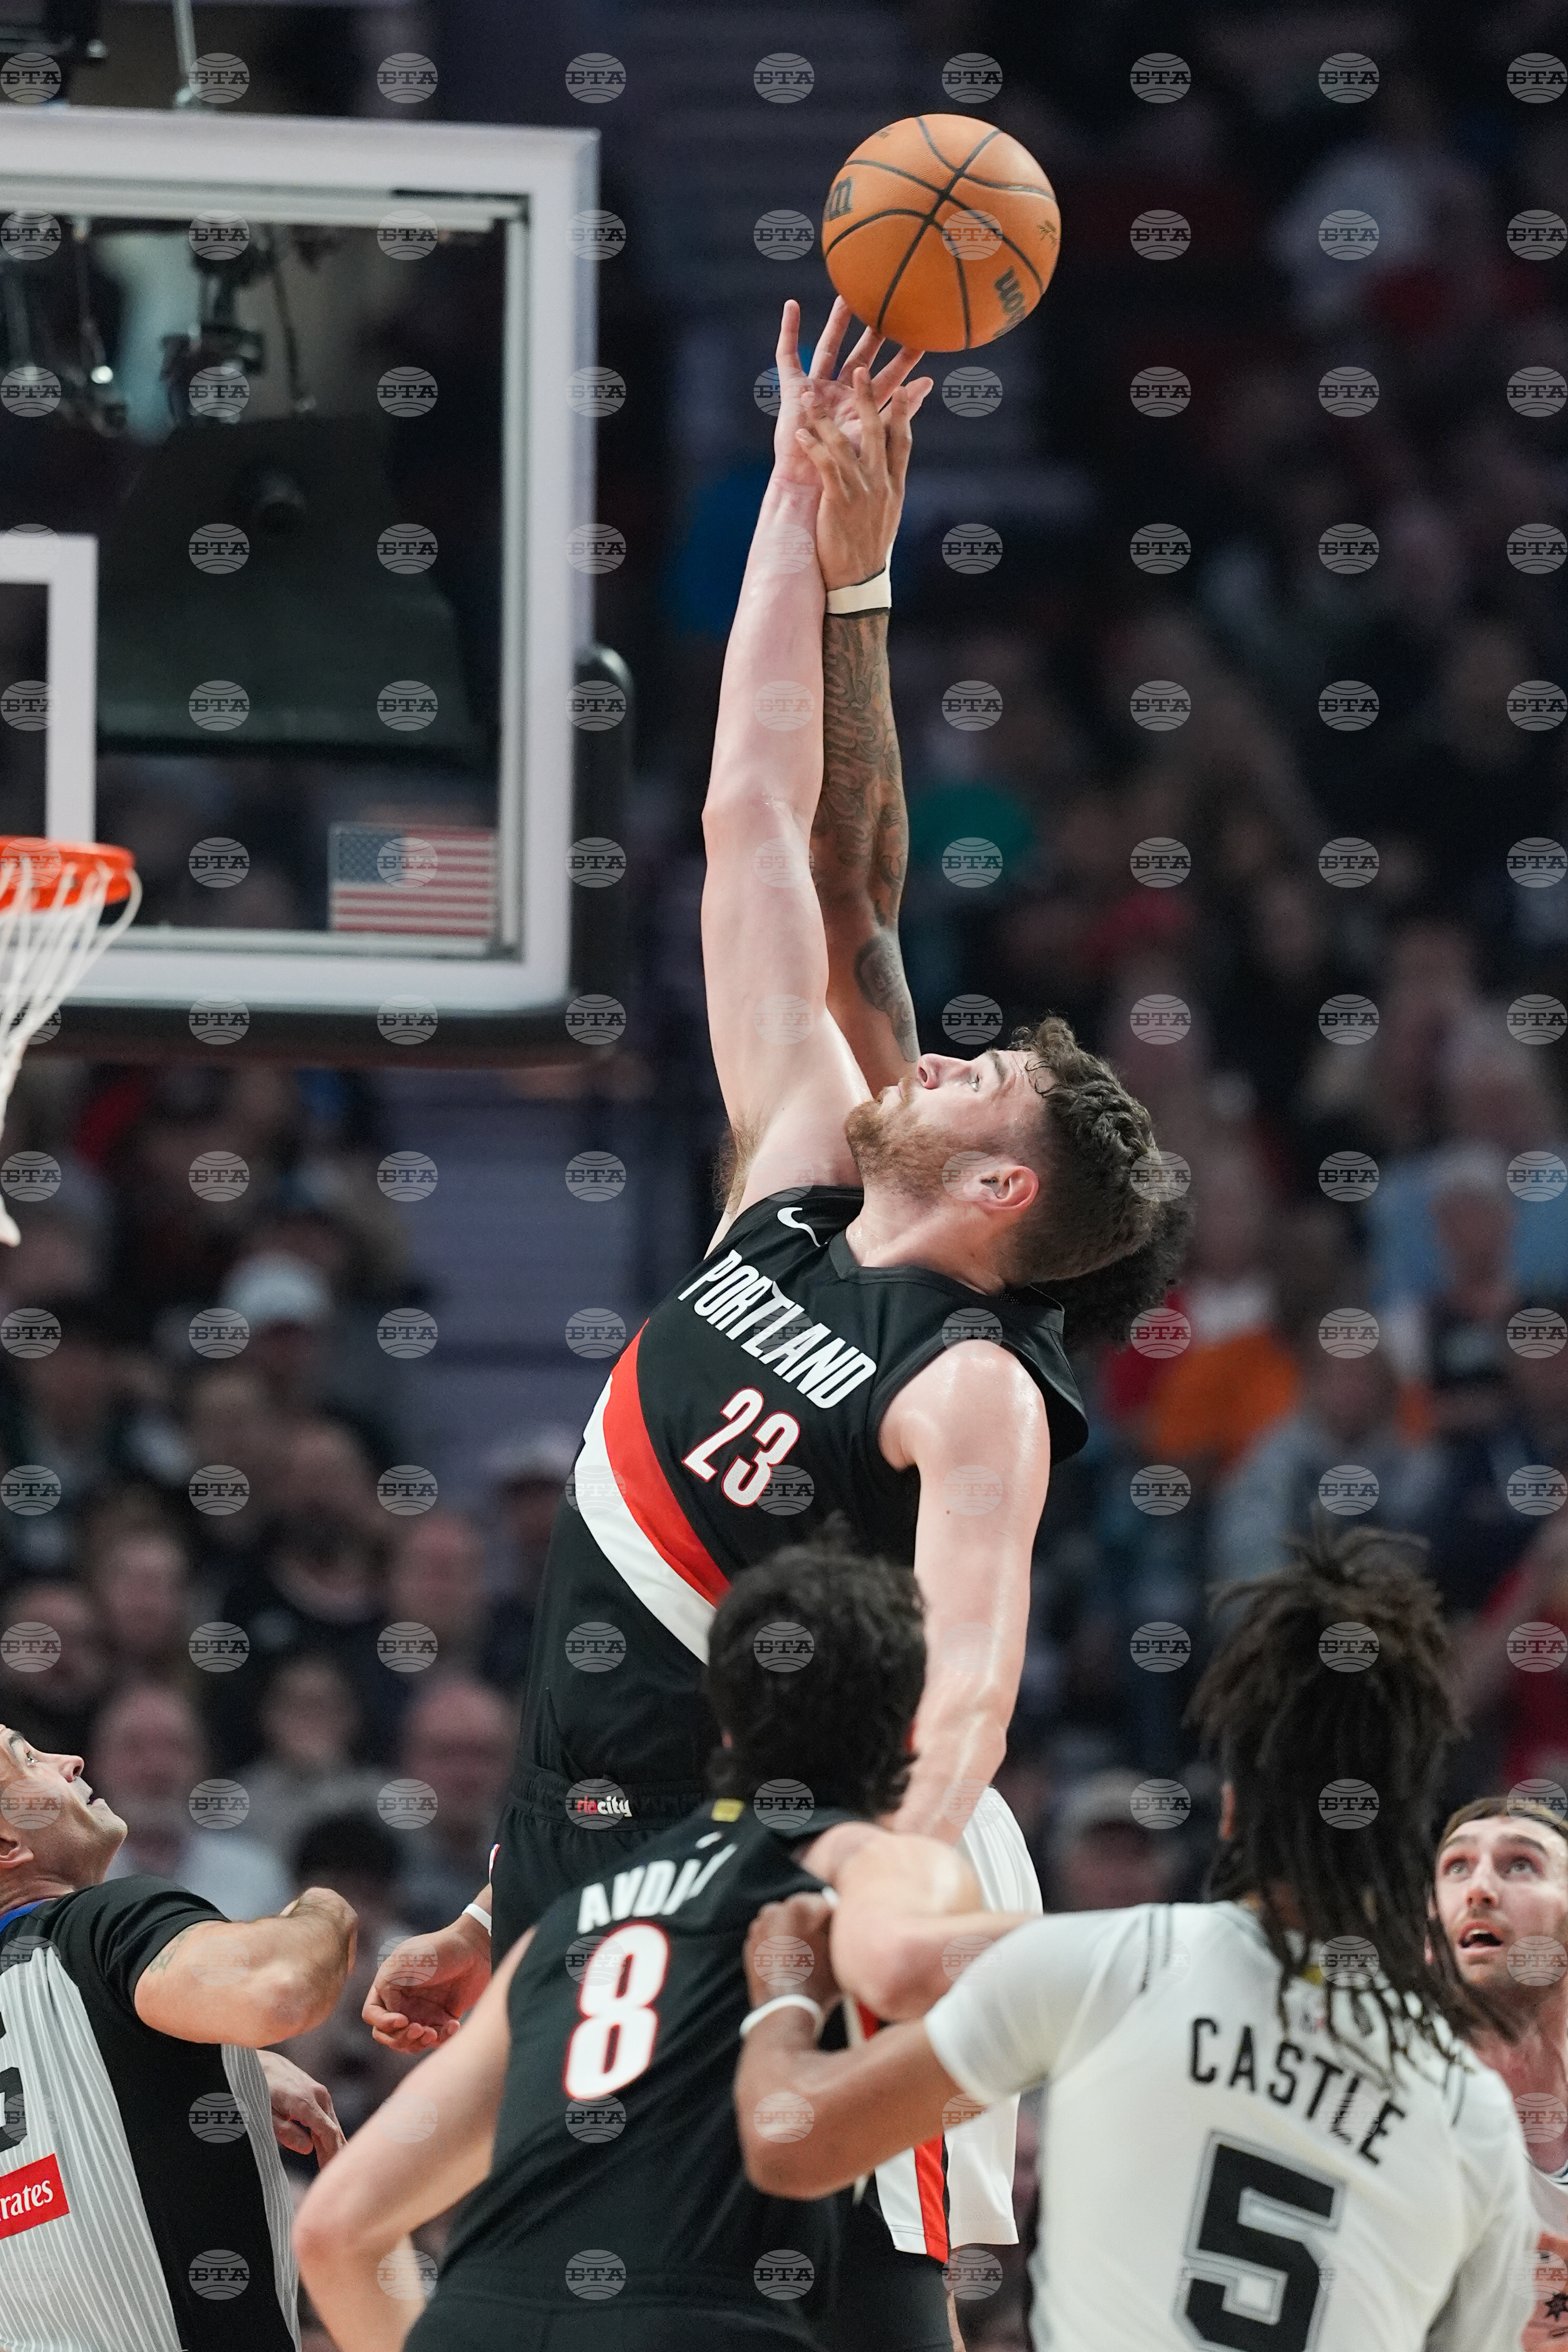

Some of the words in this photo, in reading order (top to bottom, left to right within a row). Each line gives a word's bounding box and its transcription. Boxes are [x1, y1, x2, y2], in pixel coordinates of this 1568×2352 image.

[678, 1249, 877, 1408] PORTLAND
[681, 1387, 800, 1507] 23
[577, 1831, 737, 1934] AVDI
[563, 1921, 670, 2100] 8
[1190, 2017, 1405, 2166] CASTLE
[0, 2180, 53, 2221] rates
[1172, 2129, 1347, 2352] 5
